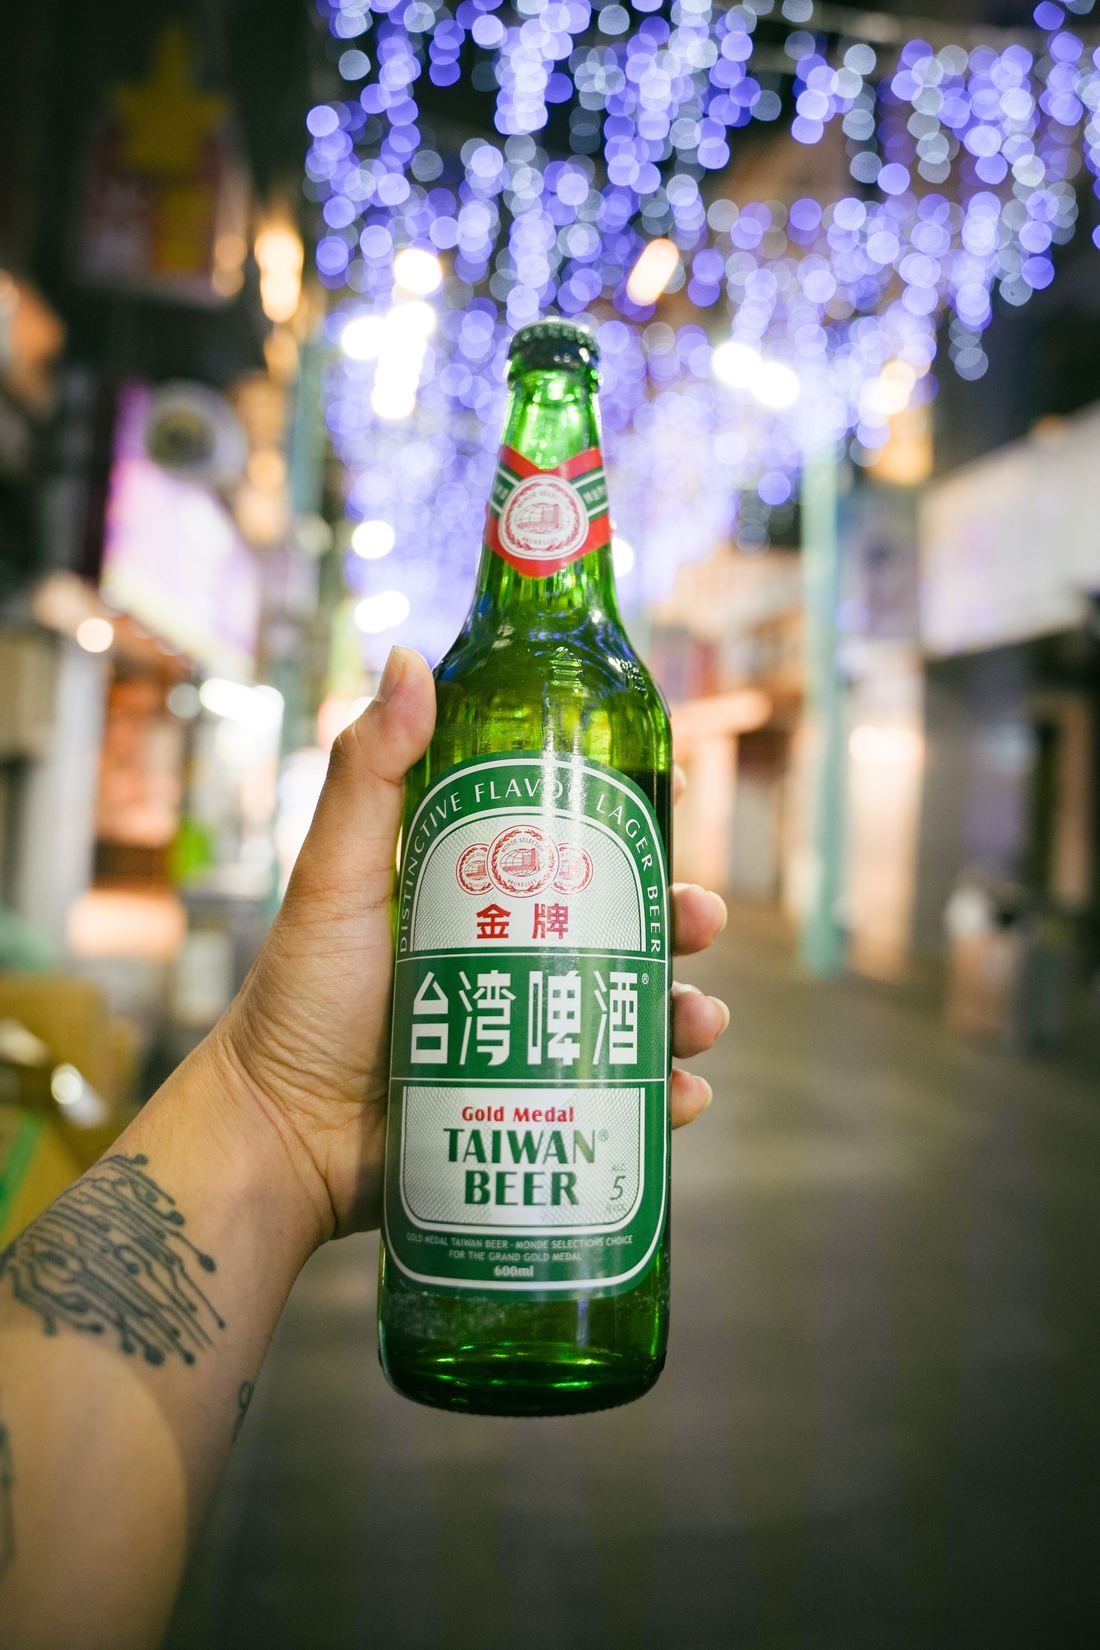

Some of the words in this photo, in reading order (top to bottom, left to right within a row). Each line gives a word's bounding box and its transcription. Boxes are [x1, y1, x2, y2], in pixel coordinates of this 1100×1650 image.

[400, 792, 463, 952] DISTINCTIVE
[596, 793, 653, 872] LAGER
[646, 885, 661, 953] BEER
[411, 969, 638, 1066] 台湾啤酒
[462, 1106, 504, 1123] Gold
[513, 1106, 574, 1123] Medal
[443, 1128, 596, 1164] TAIWAN
[464, 1170, 579, 1206] BEER
[609, 1175, 626, 1201] 5
[406, 1232, 423, 1242] GOLD
[425, 1235, 448, 1246] MEDAL
[451, 1237, 482, 1248] TAIWAN
[485, 1239, 508, 1249] BEER
[515, 1240, 548, 1249] MONDE
[606, 1235, 632, 1246] CHOICE
[448, 1249, 465, 1259] FOR
[468, 1250, 485, 1260] THE
[488, 1252, 521, 1261] GRAND
[524, 1252, 549, 1261] GOLD
[552, 1251, 582, 1261] MEDAL
[494, 1264, 534, 1277] 600ml
